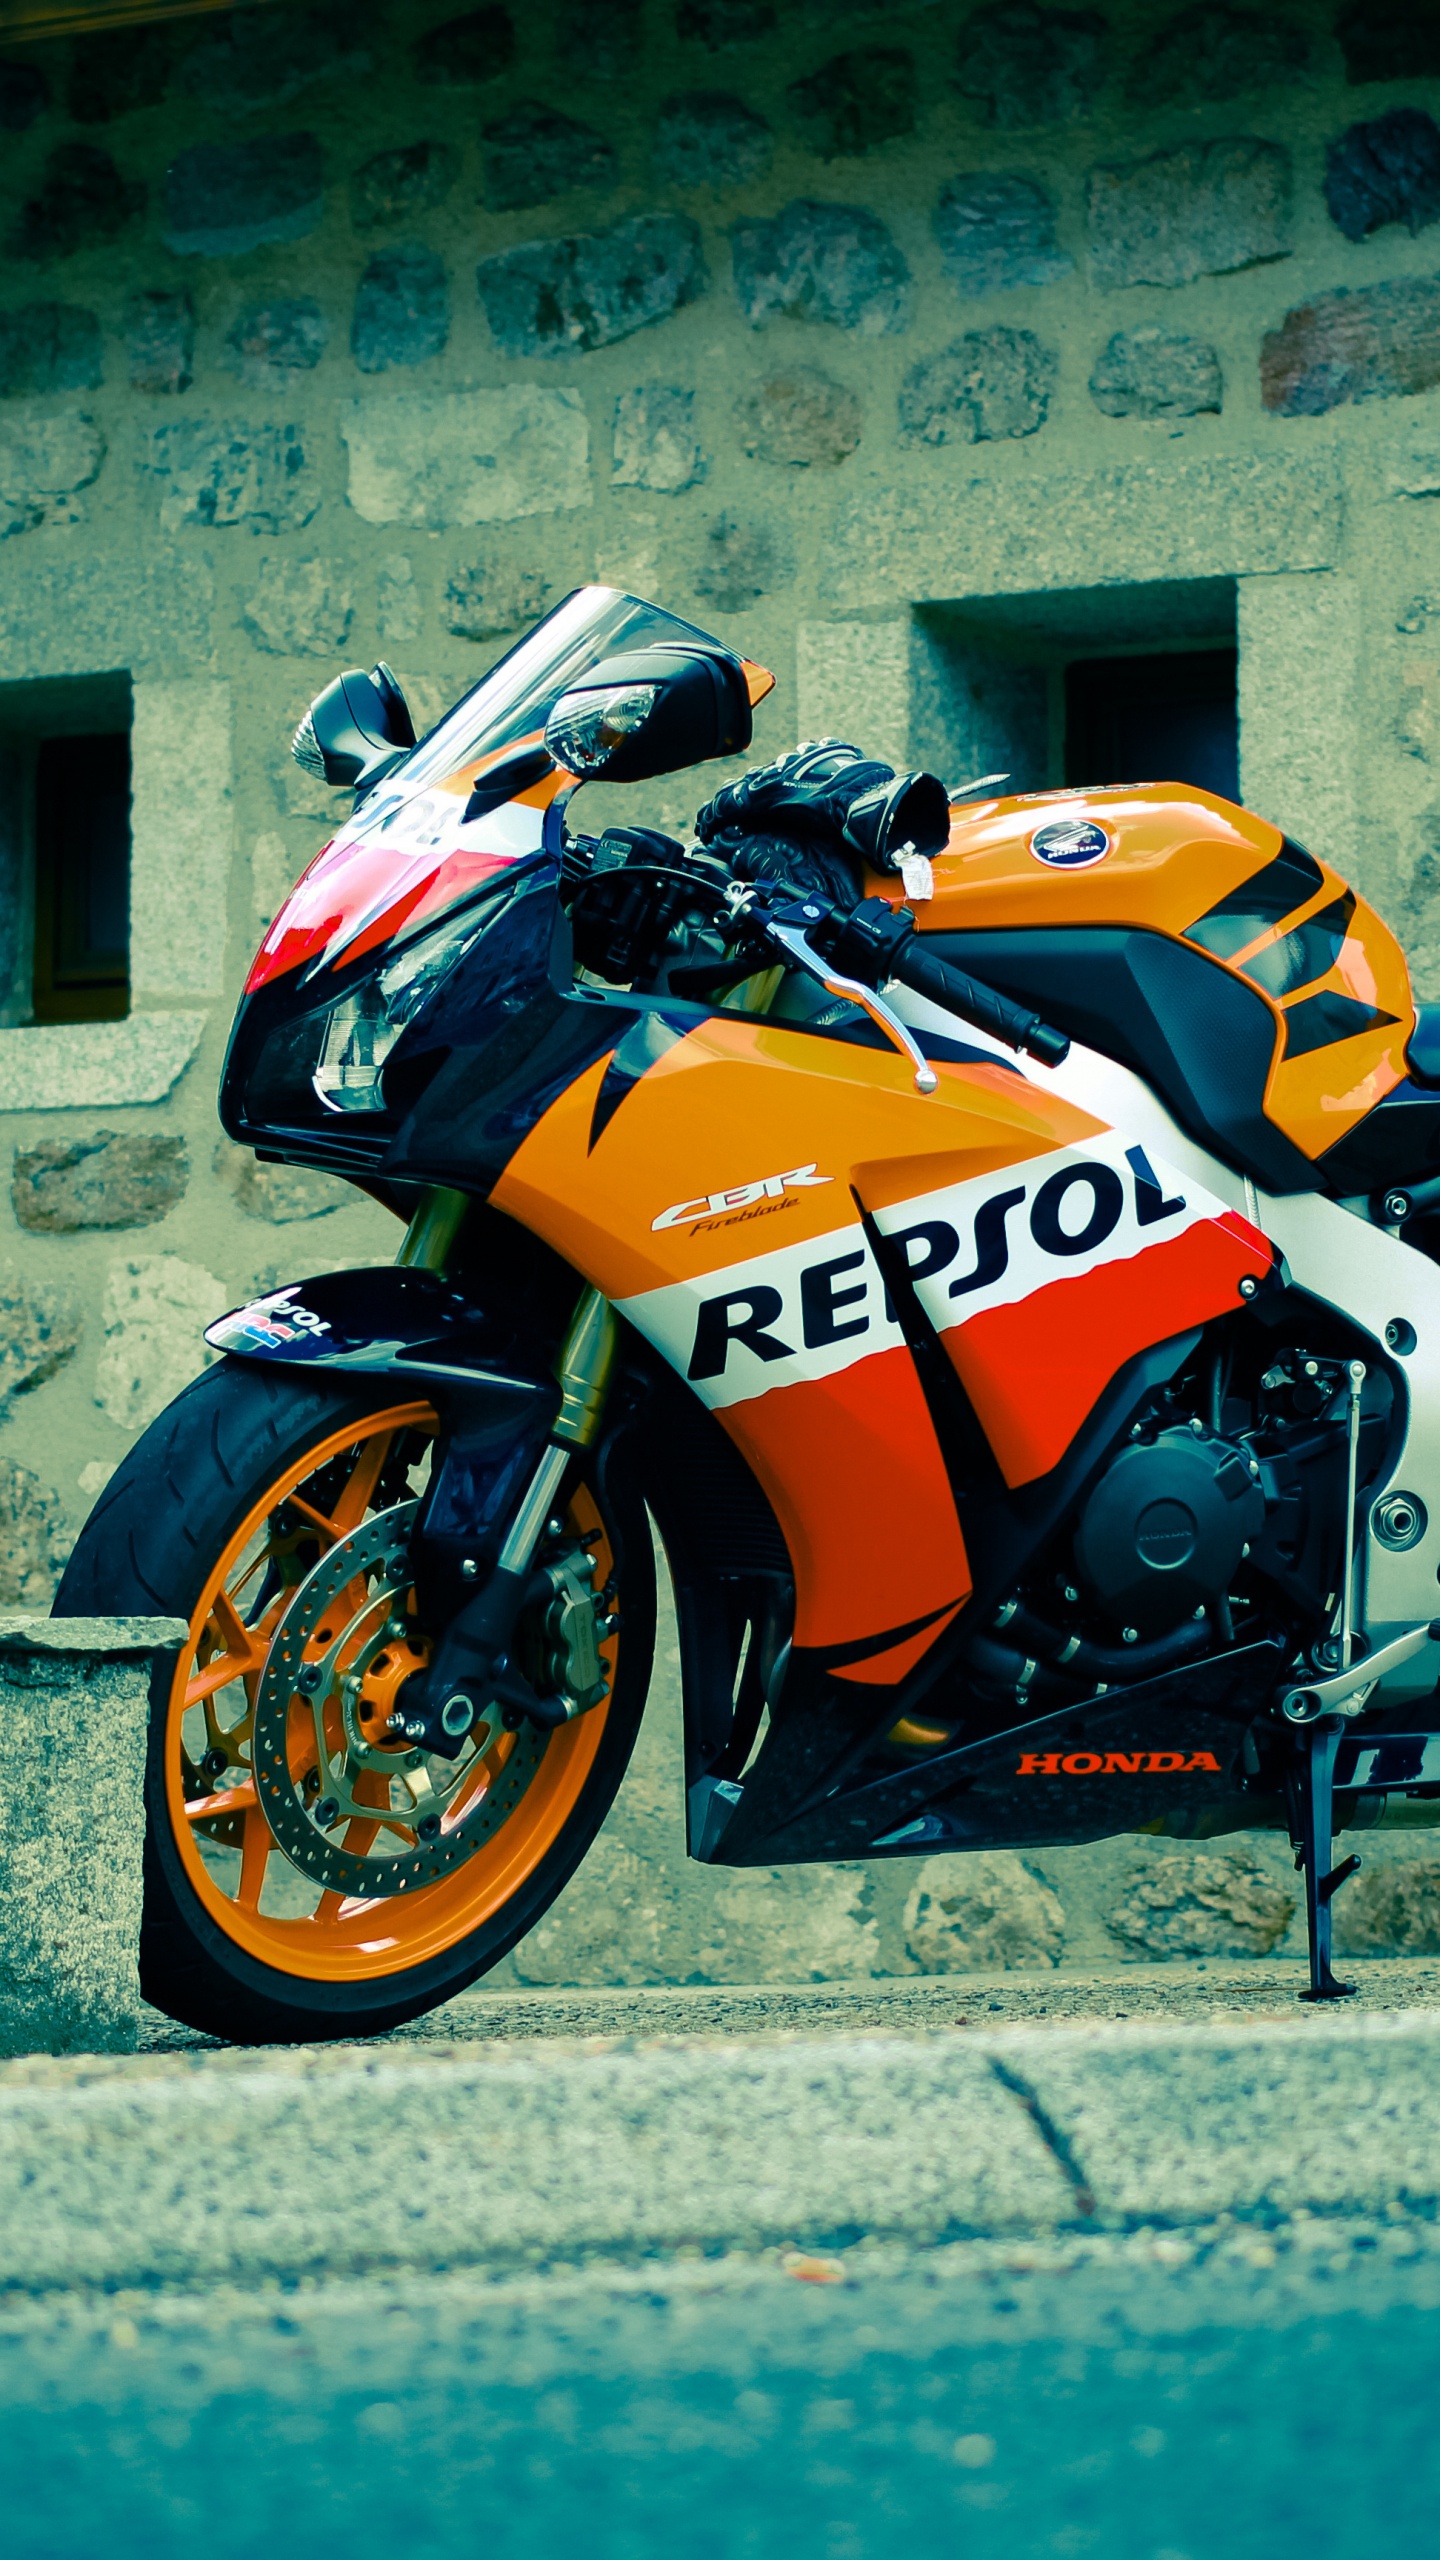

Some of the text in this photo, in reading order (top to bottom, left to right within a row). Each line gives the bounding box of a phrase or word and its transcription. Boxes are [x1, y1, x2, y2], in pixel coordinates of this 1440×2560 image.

[1047, 842, 1101, 859] HONDA
[650, 1162, 835, 1232] CBR
[689, 1197, 800, 1237] Fireblade
[687, 1144, 1187, 1381] REPSOL
[237, 1298, 332, 1337] PSOL
[1016, 1752, 1221, 1774] HONDA
